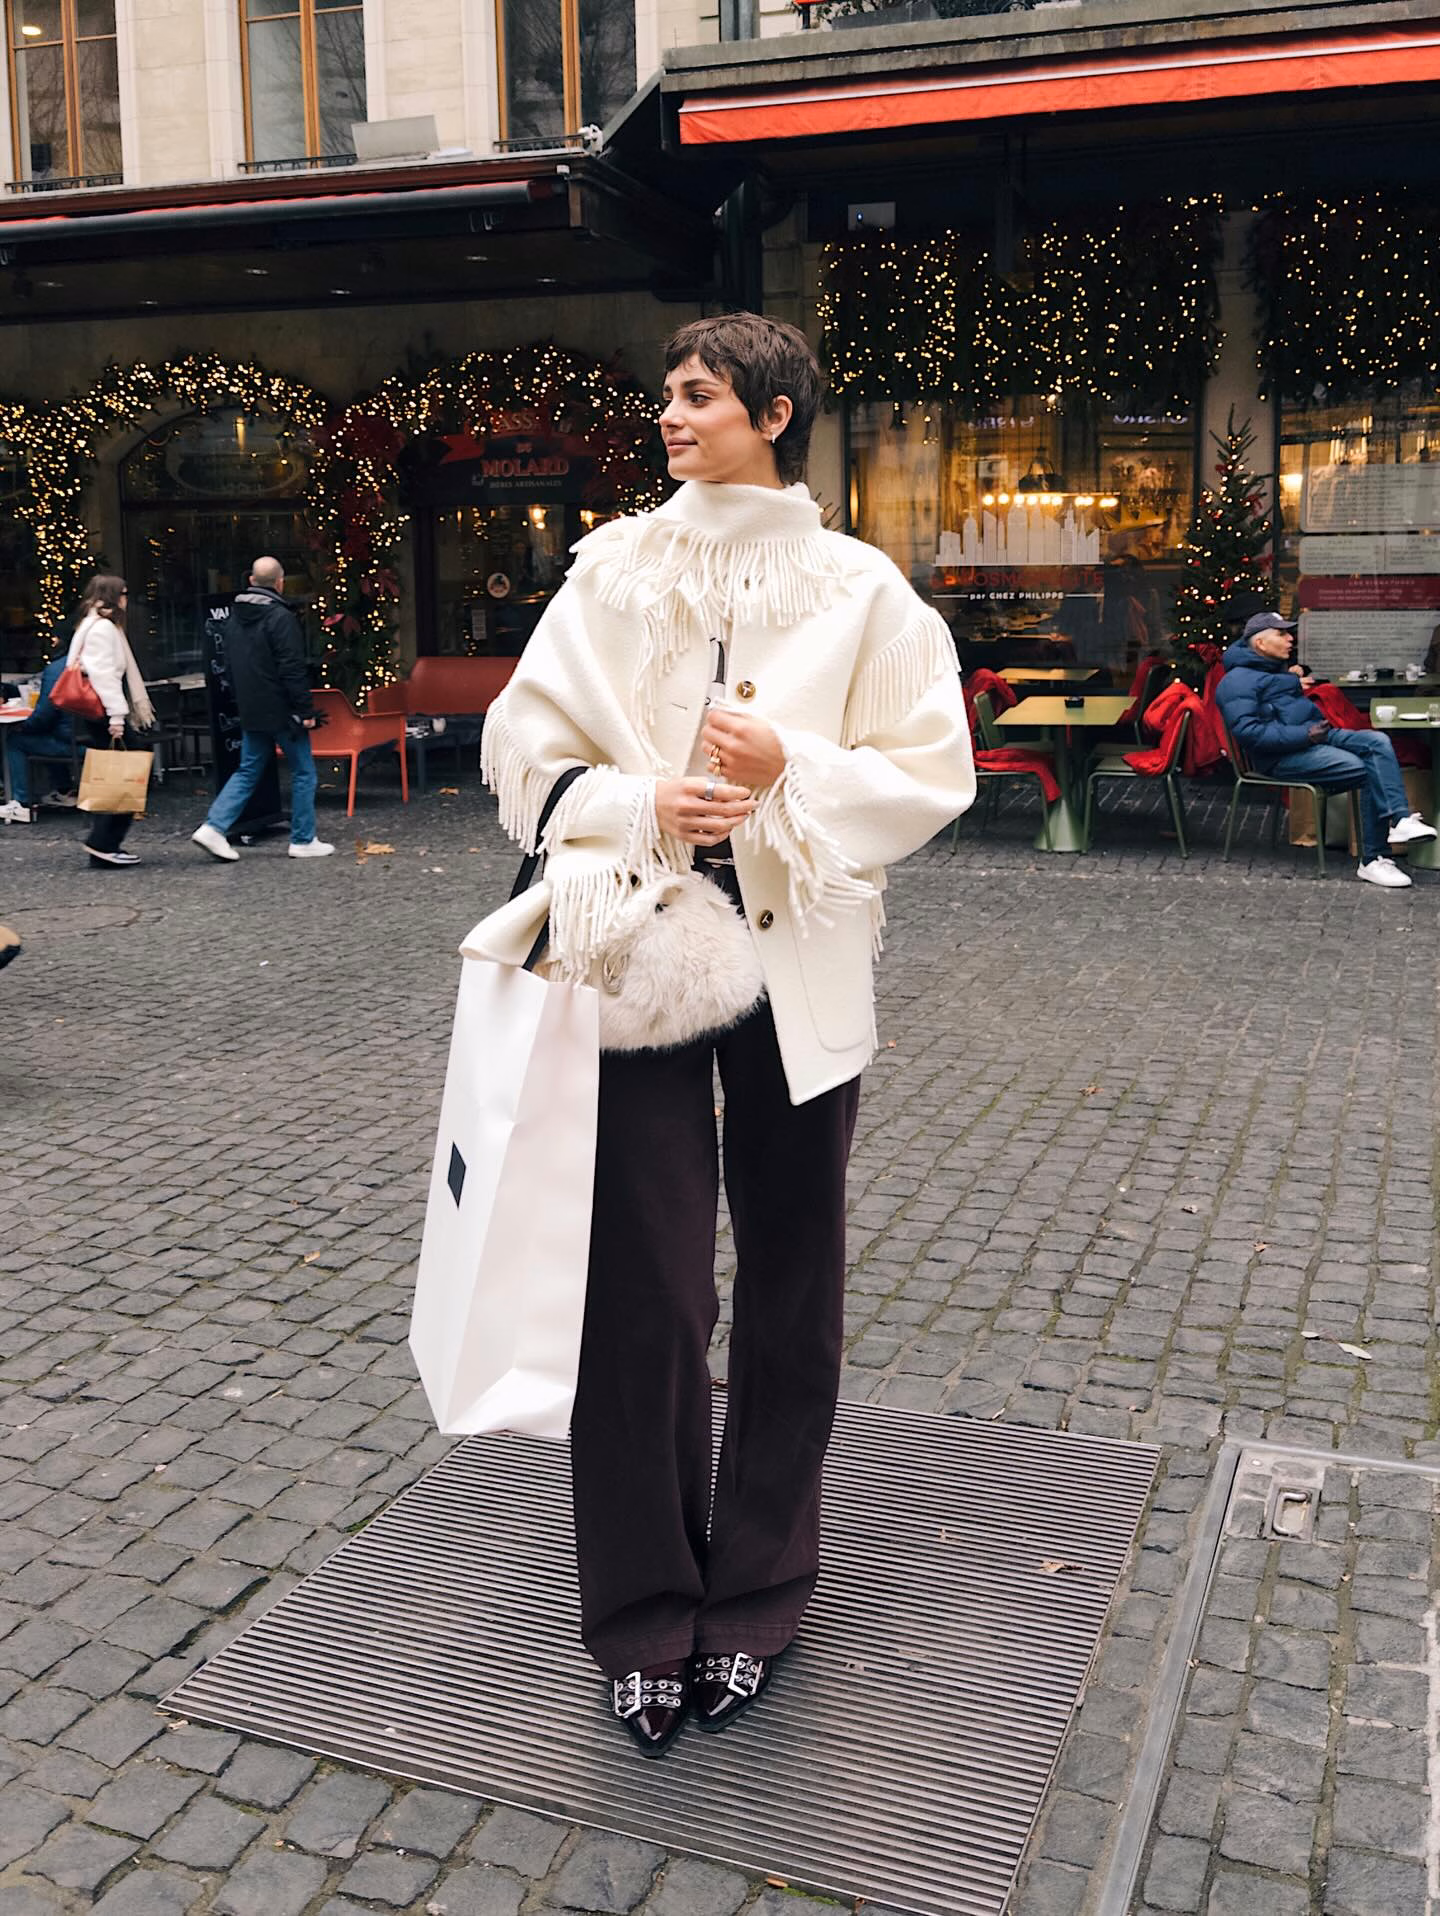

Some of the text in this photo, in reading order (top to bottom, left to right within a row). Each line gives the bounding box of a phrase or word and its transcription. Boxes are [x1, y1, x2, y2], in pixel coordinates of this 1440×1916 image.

[482, 458, 570, 478] MOLARD
[989, 592, 1015, 600] CHEZ
[1018, 592, 1065, 600] PHILIPPE
